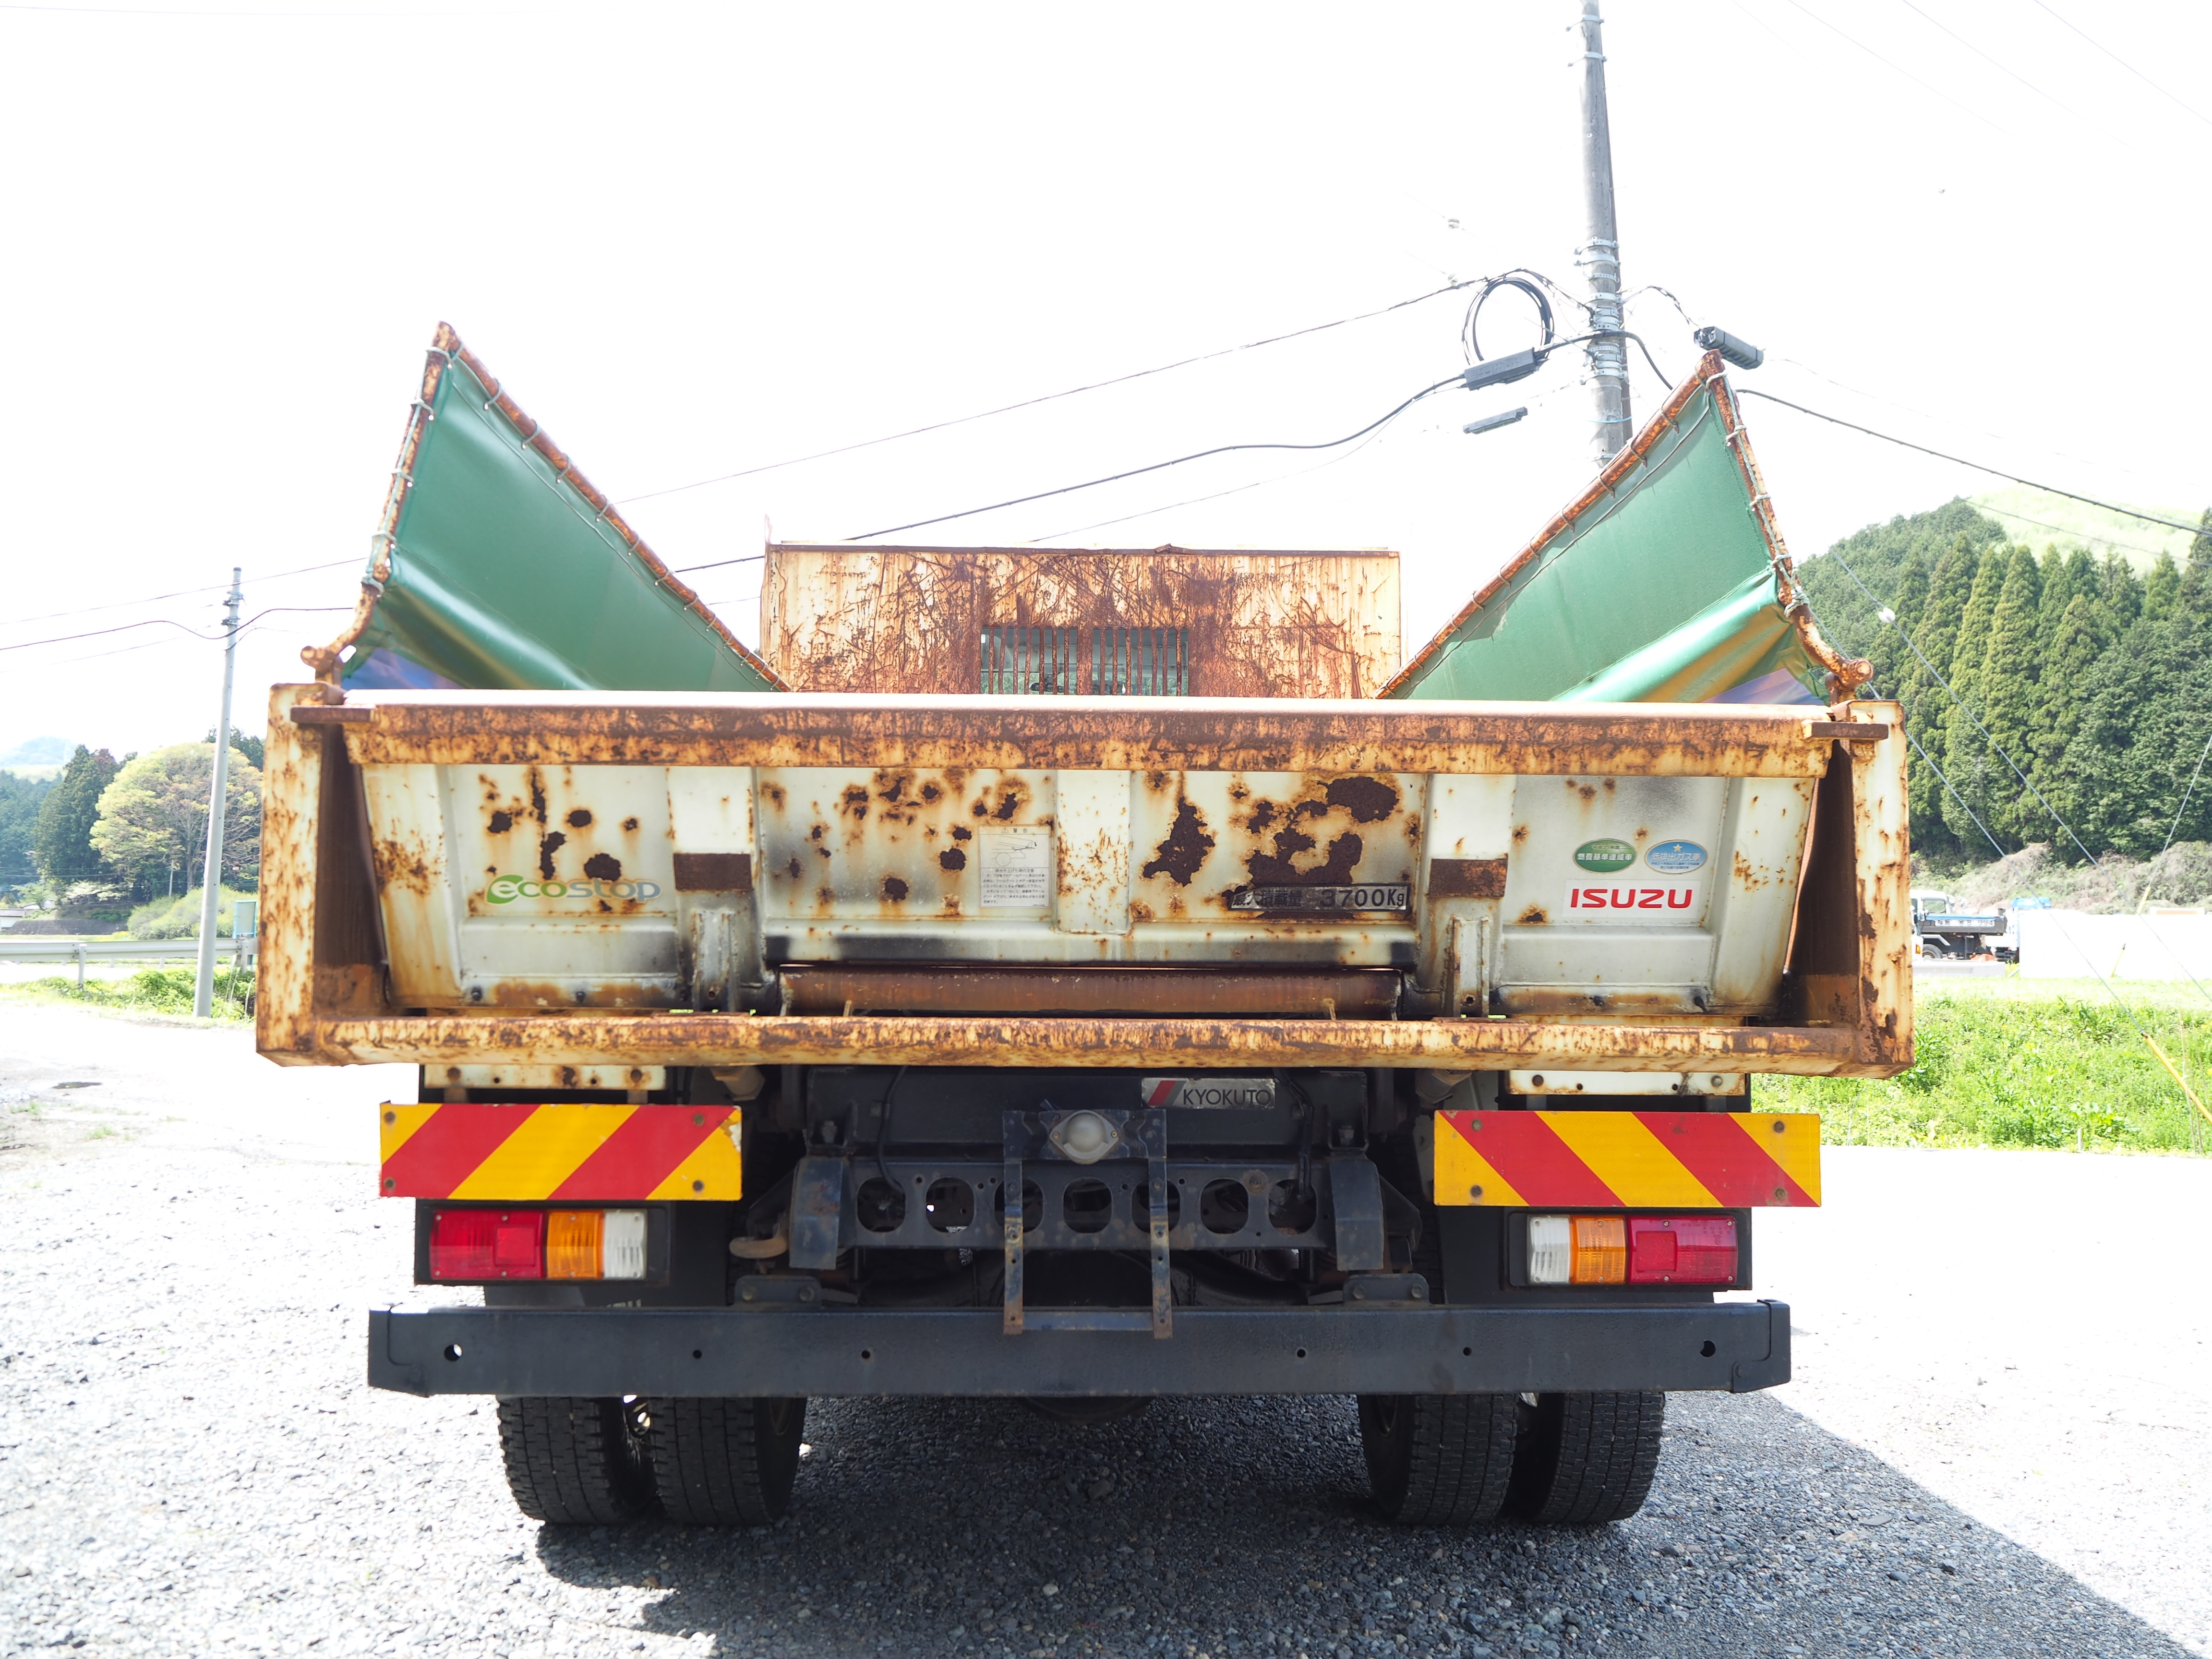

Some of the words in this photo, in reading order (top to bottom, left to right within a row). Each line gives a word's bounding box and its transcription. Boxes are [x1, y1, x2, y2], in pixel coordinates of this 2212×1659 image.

[1652, 853, 1701, 862] 低排出ガス車
[1570, 888, 1693, 908] ISUZU
[1183, 1089, 1271, 1105] KYOKUTO
